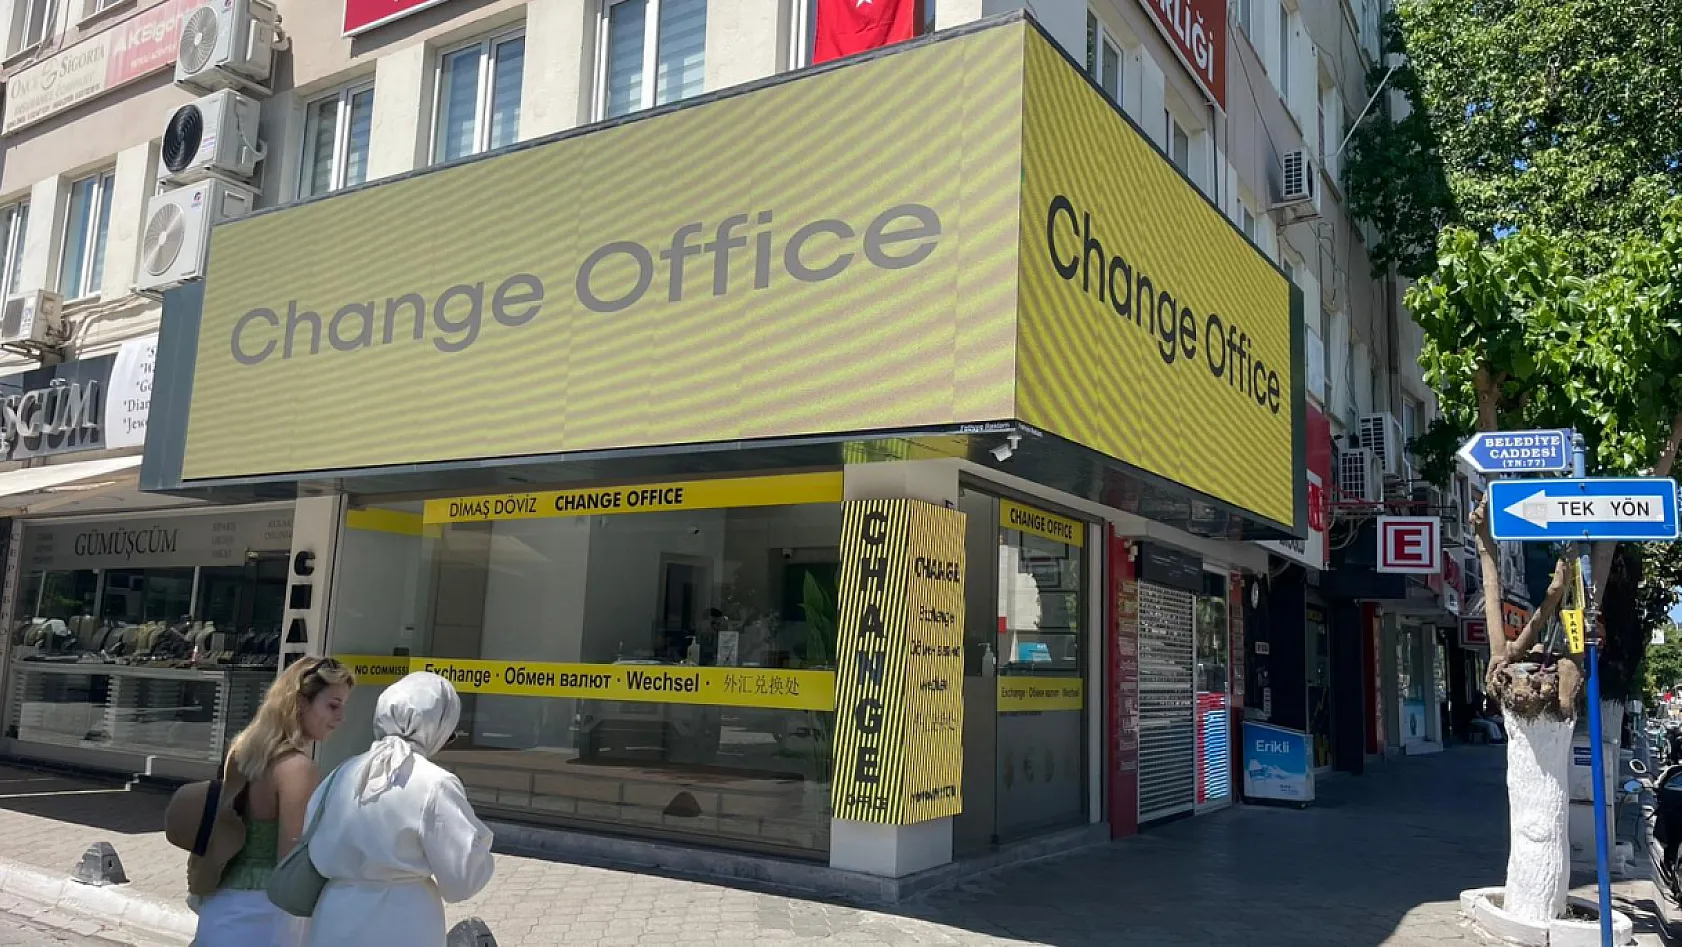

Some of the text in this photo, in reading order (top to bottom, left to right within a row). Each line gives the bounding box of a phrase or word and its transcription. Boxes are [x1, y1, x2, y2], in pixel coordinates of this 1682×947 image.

[230, 203, 942, 365] Change Office
[1047, 195, 1280, 414] Change Office
[1485, 435, 1560, 448] BELEDİYE
[1490, 446, 1556, 459] CADDESİ
[450, 488, 683, 519] DİMAŞ DÖVİZ CHANGE OFFICE
[1558, 497, 1650, 516] TEK YÖN
[1010, 508, 1073, 539] CHANGE OFFICE
[75, 524, 179, 561] GÜMÜŞCÜM
[1394, 530, 1422, 560] E
[355, 665, 368, 675] NO
[505, 666, 612, 689] Обмен валют
[626, 671, 700, 693] Wechsel
[723, 674, 800, 696] 外汇兑换处
[1255, 739, 1291, 754] Erikli
